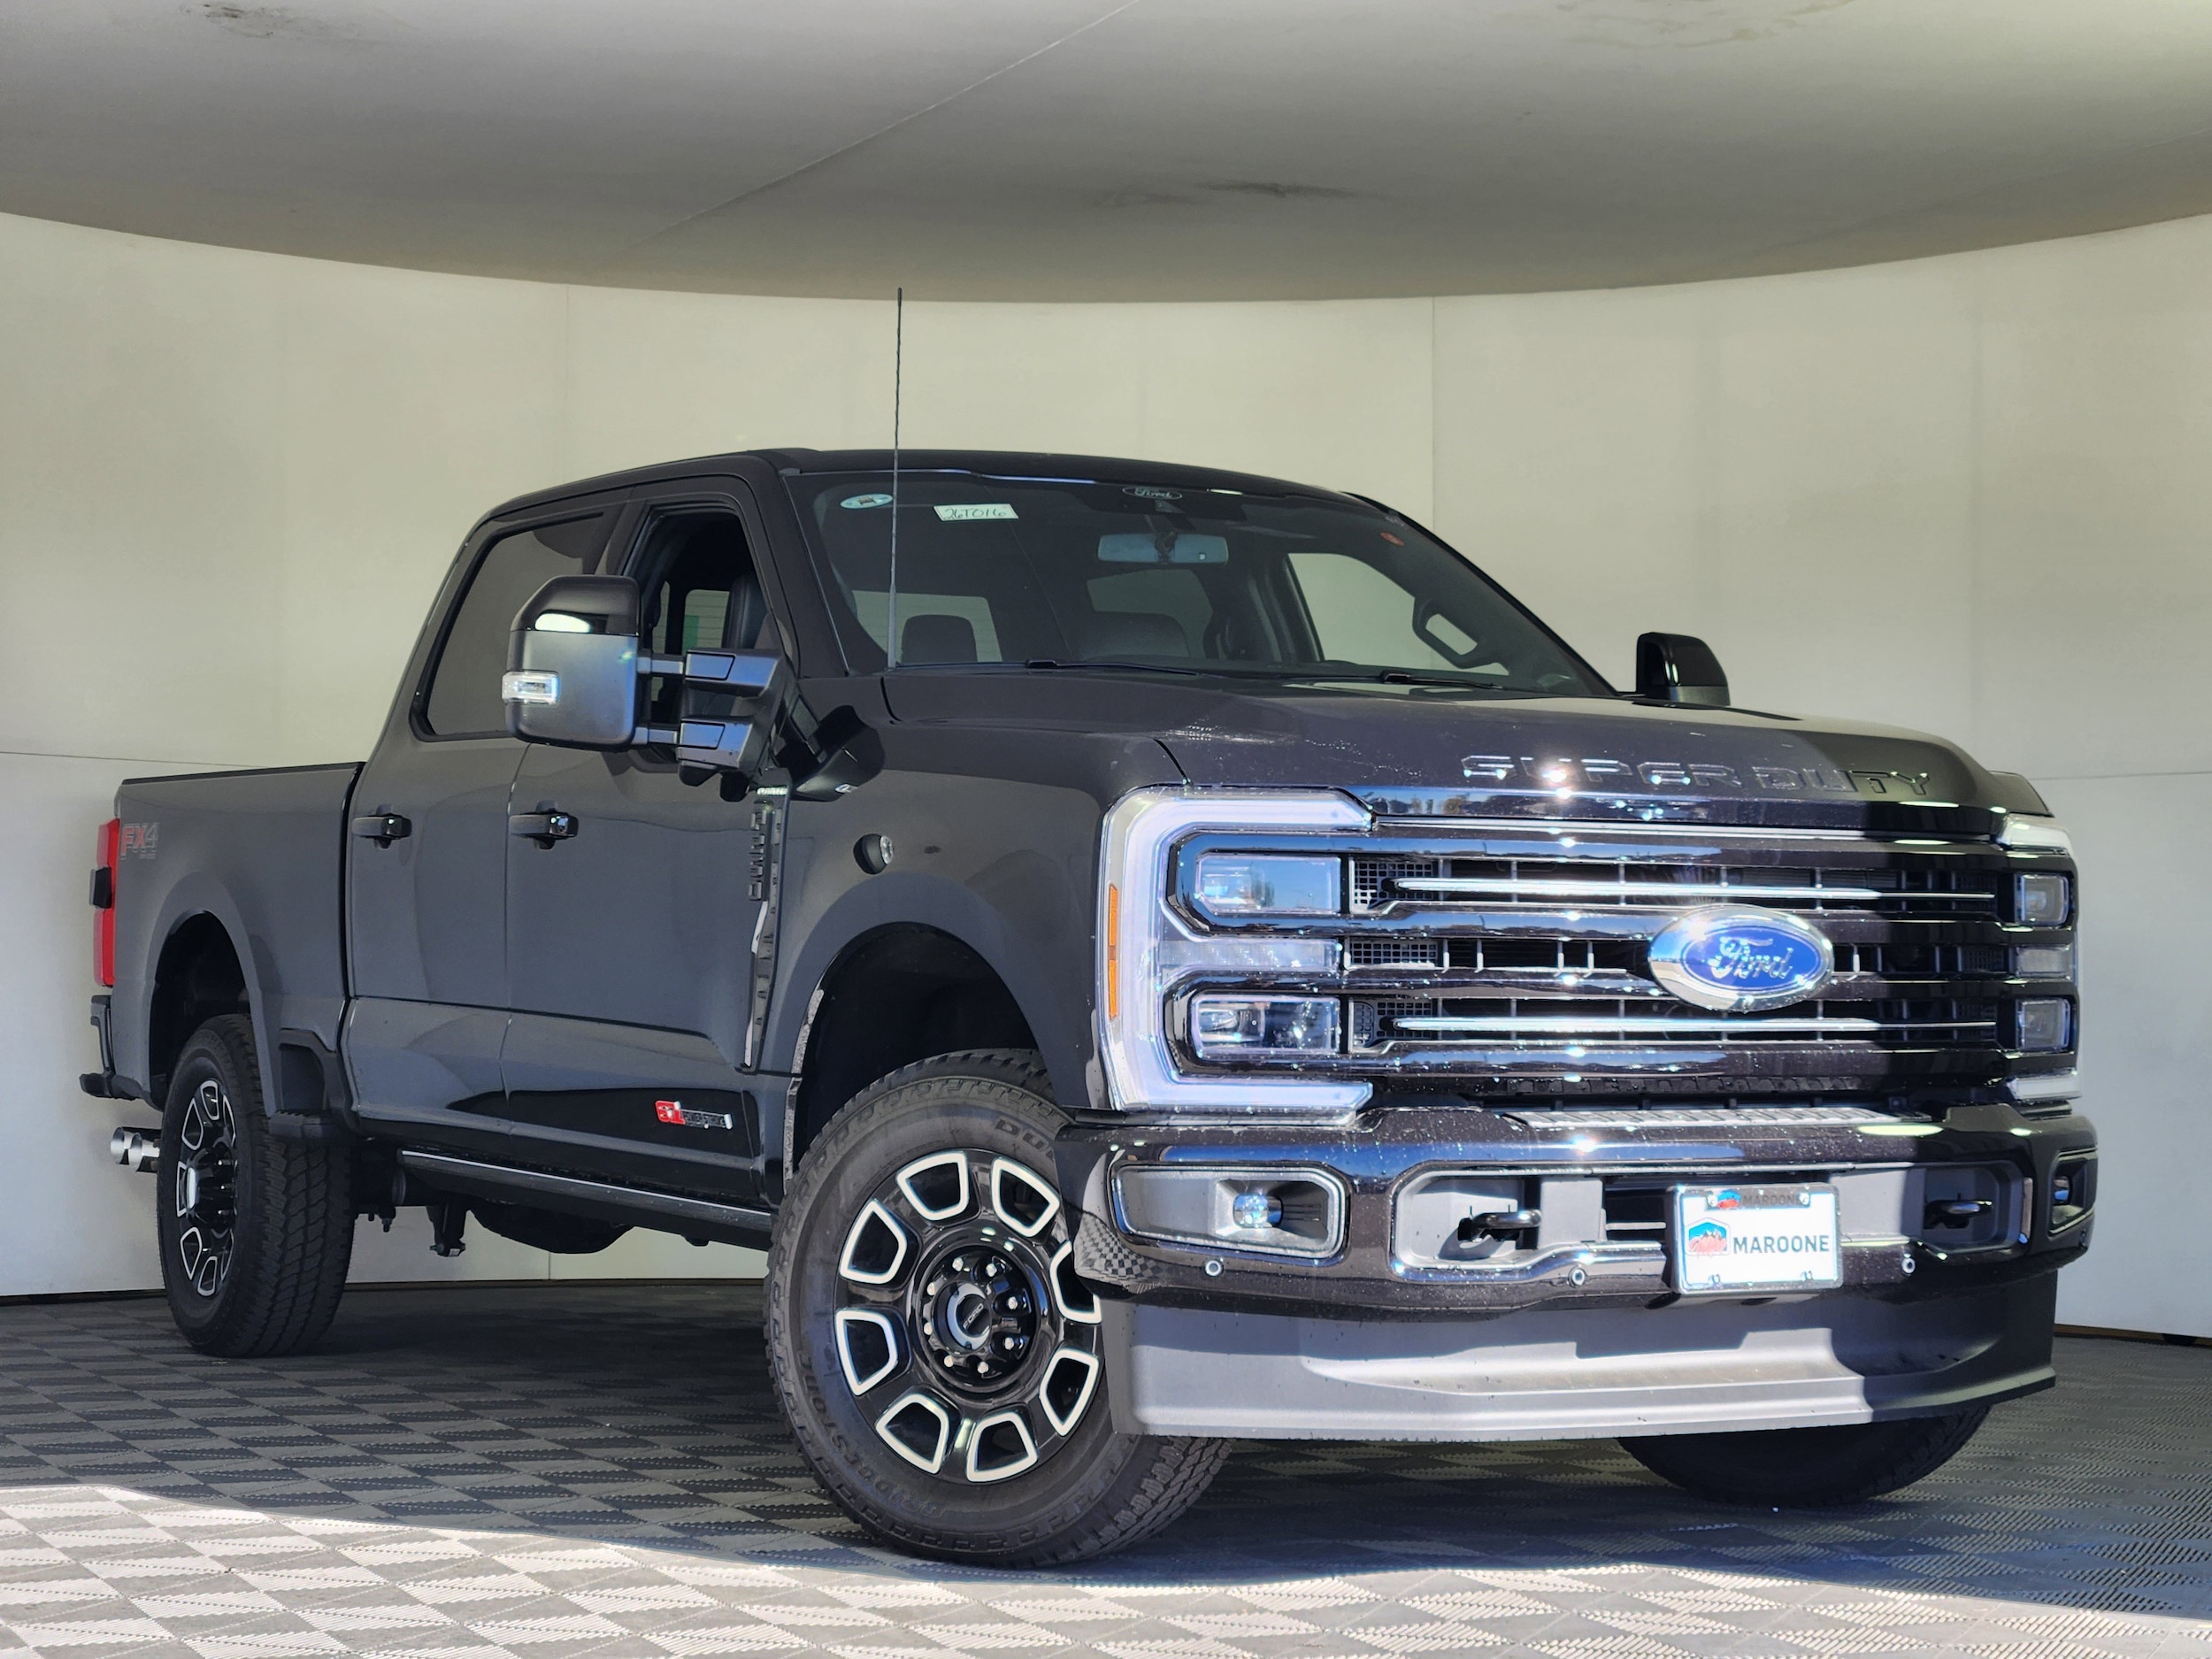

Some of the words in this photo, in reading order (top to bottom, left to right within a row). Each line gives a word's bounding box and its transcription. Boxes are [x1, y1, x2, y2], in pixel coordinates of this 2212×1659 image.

[1461, 755, 1742, 787] SUPER
[1751, 765, 1931, 795] DUTY
[120, 823, 158, 860] FX4
[1707, 936, 1794, 979] Ford
[1742, 1194, 1801, 1206] MAROON
[1733, 1234, 1830, 1255] MAROONE
[963, 1303, 984, 1330] FORD
